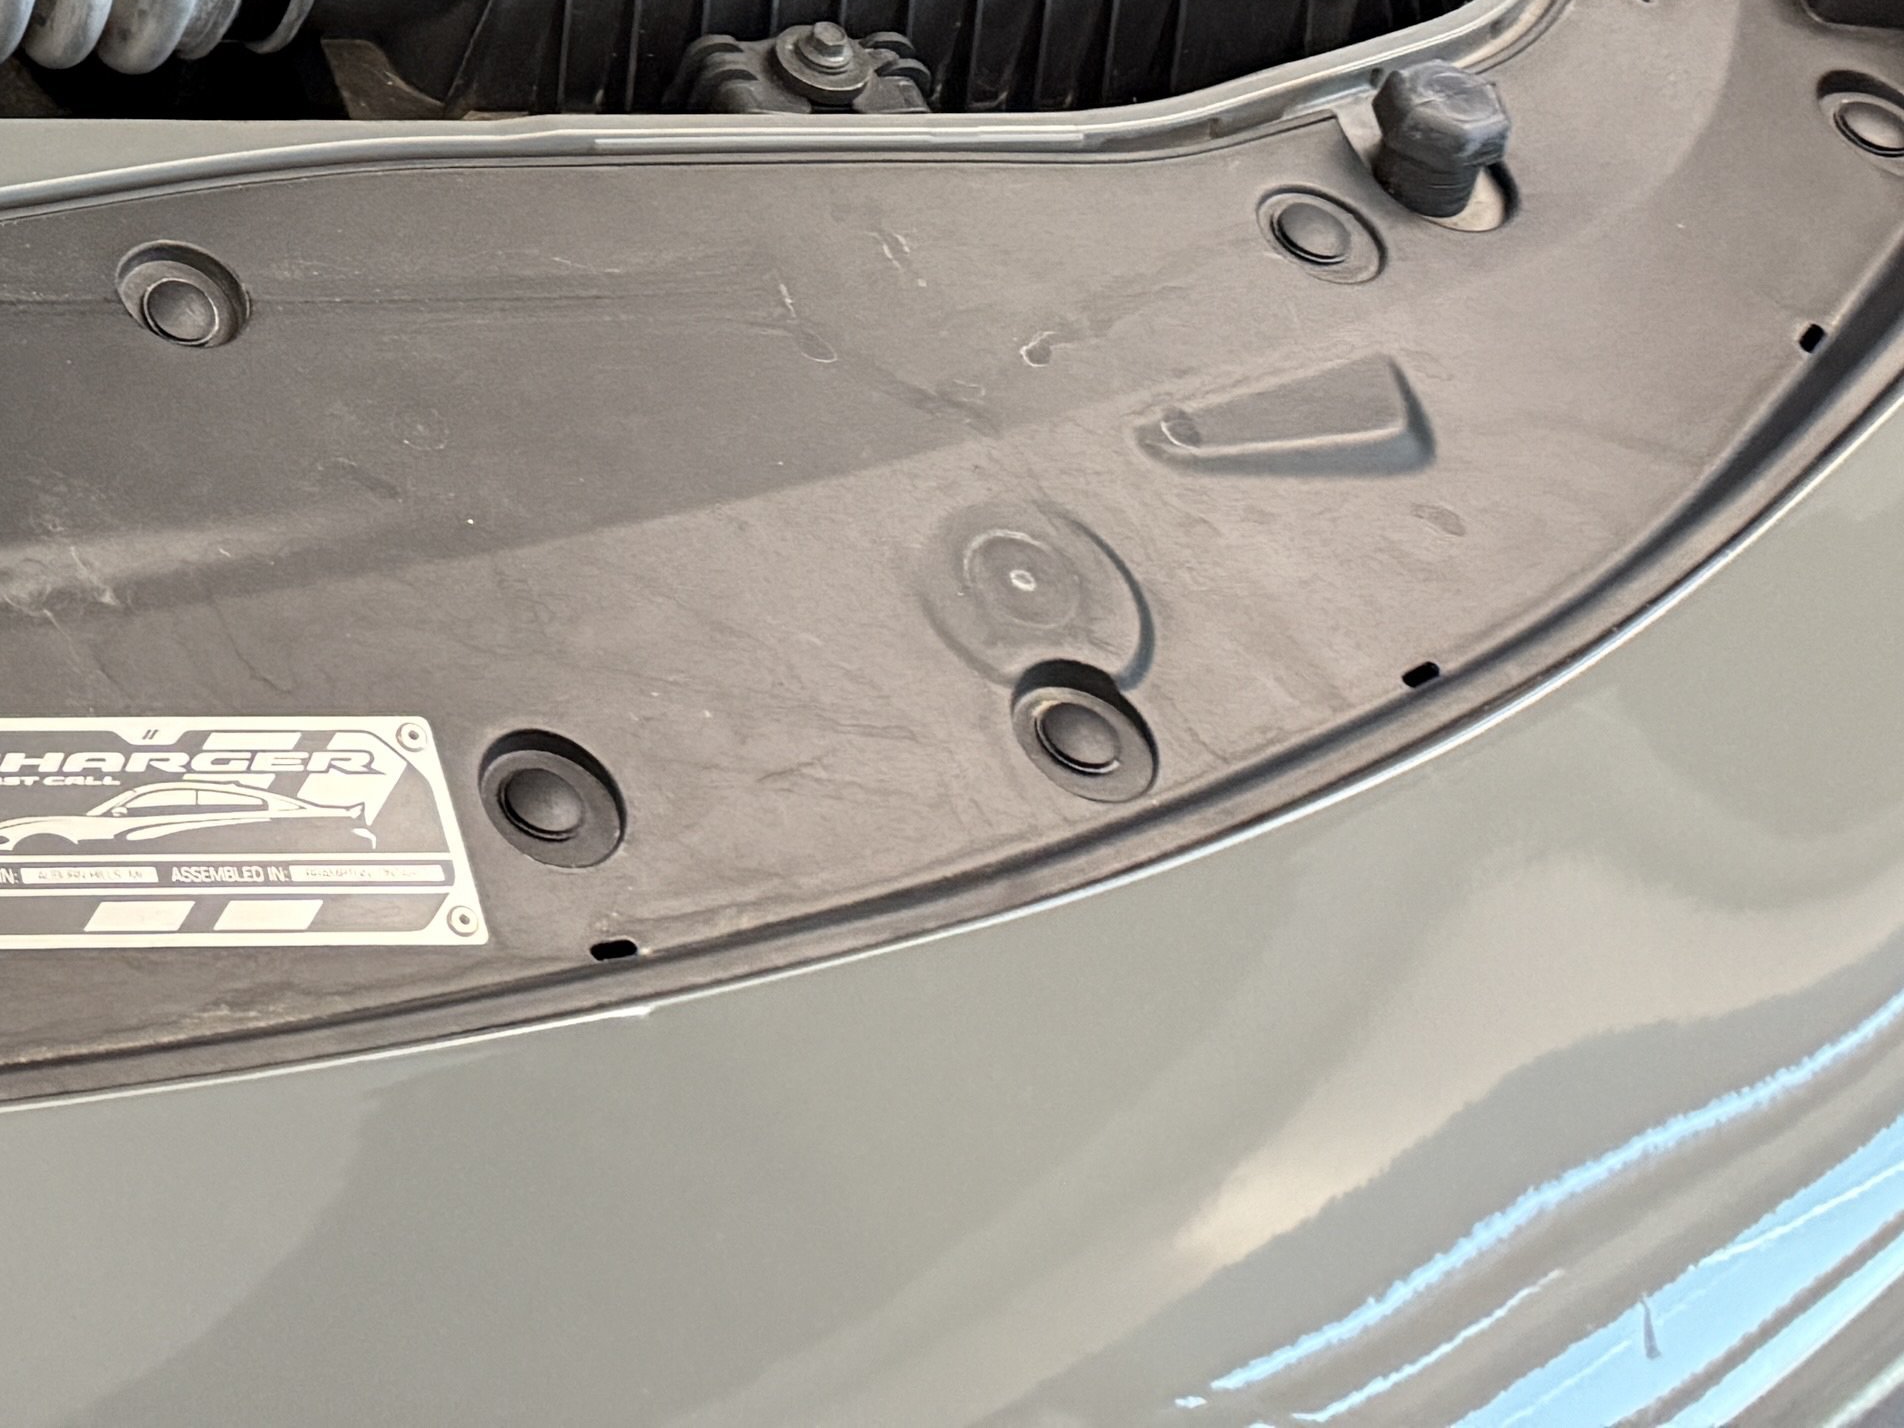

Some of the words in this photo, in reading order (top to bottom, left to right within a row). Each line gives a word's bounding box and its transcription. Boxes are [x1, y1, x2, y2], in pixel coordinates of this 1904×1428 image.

[41, 775, 122, 786] CALL
[171, 866, 265, 883] ASSEMBLED
[267, 867, 290, 882] IN:
